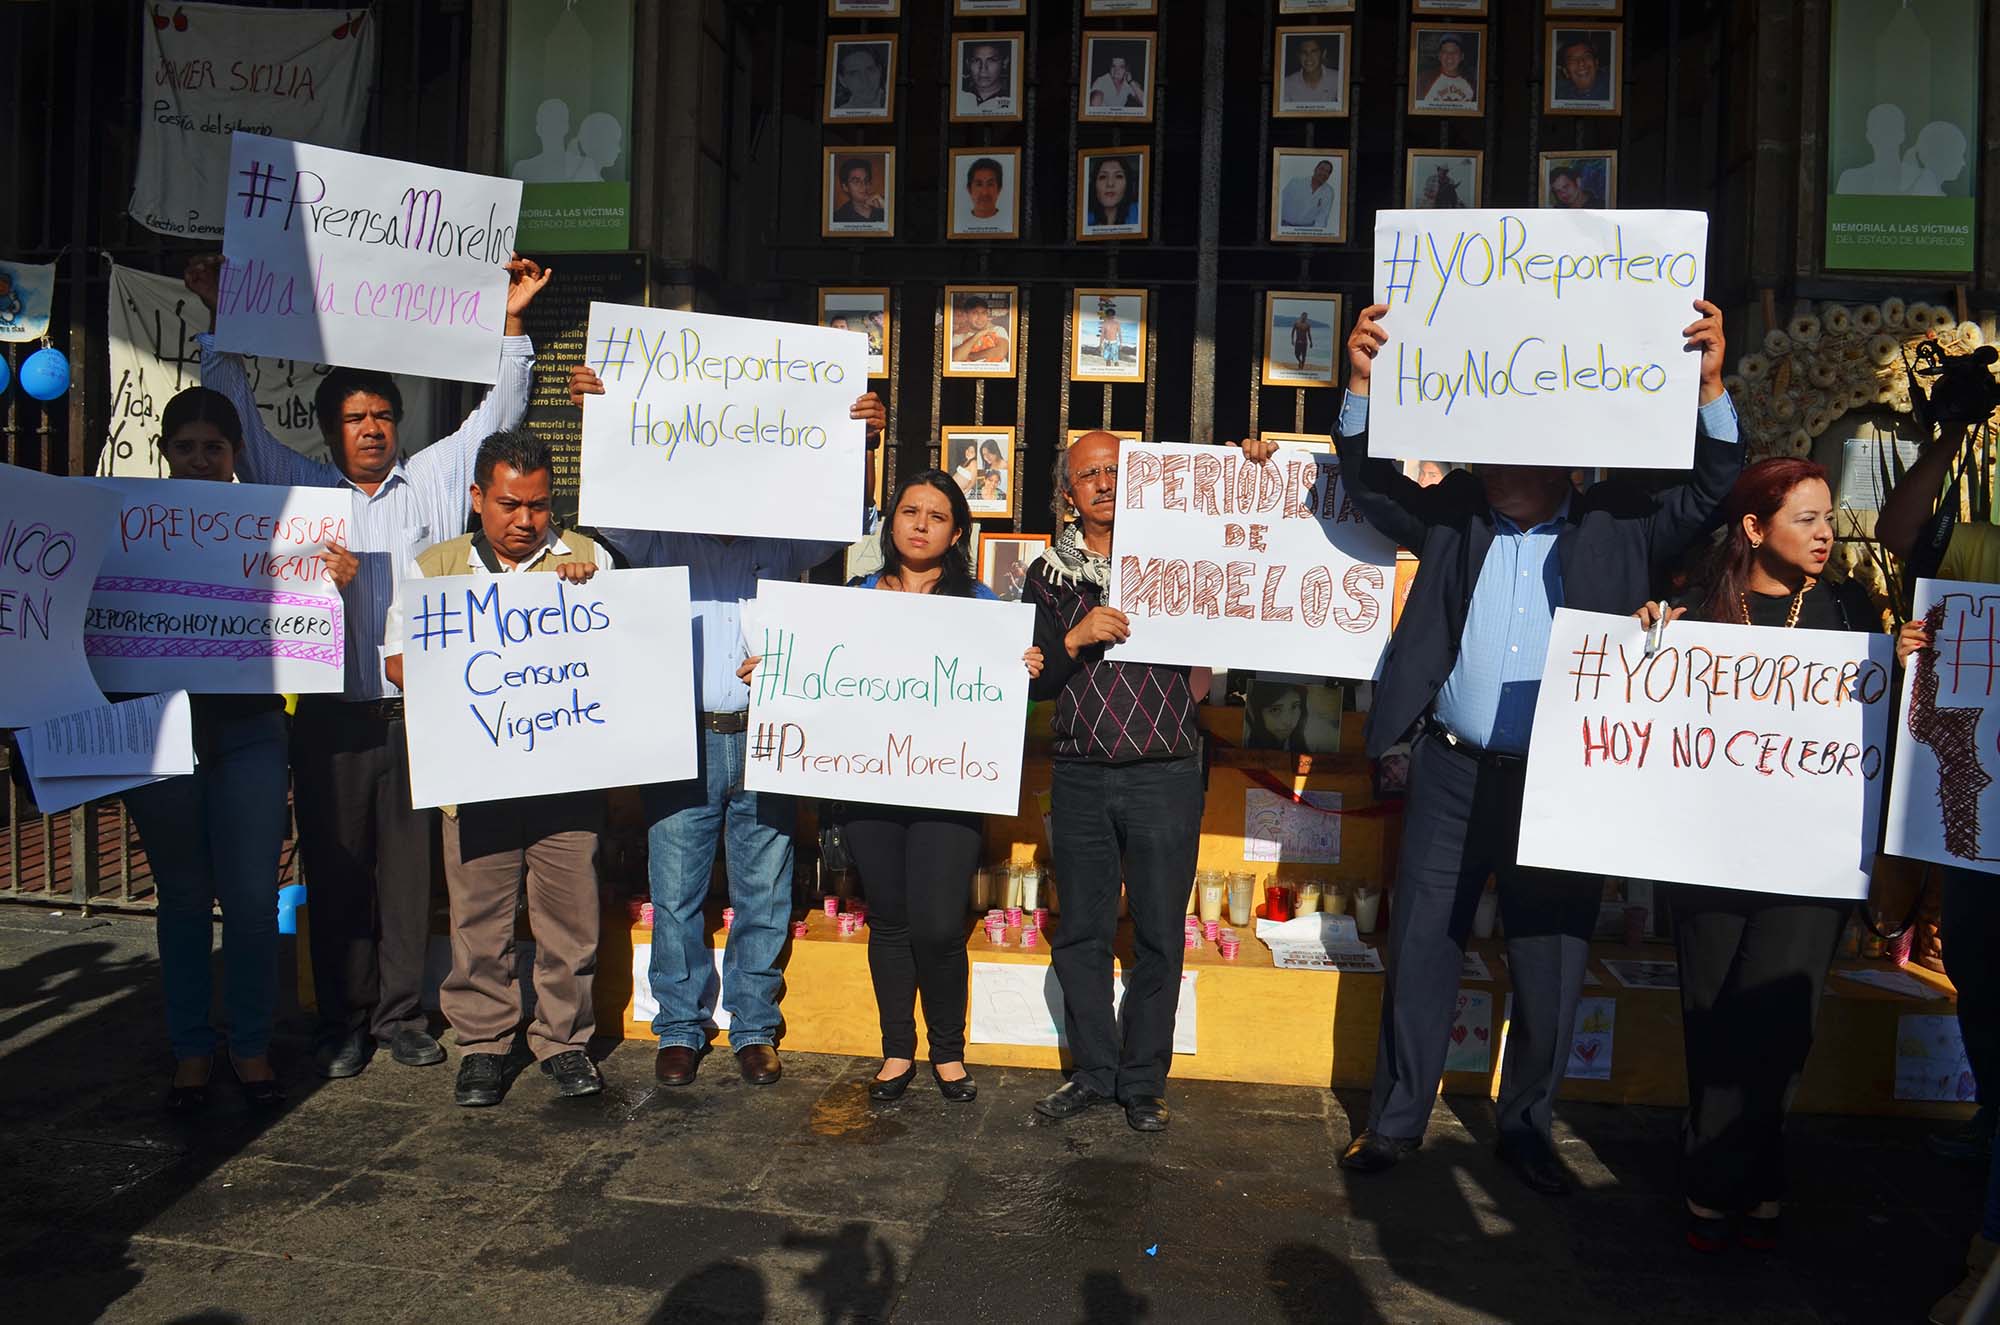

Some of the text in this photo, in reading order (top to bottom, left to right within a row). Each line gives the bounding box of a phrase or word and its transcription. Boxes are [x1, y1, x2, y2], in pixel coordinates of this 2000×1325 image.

[156, 57, 315, 101] JAVIER SICILIA
[154, 100, 195, 131] Poesía
[200, 114, 222, 135] del
[238, 161, 514, 265] #PrensaMorelos
[555, 209, 561, 217] A
[563, 208, 581, 217] LAS
[583, 205, 625, 217] VÍCTIMAS
[1832, 223, 1969, 234] MEMORIAL A LAS VÍCTIMAS
[1836, 235, 1965, 246] DEL ESTADO DE MORELOS
[312, 254, 344, 315] la
[355, 280, 494, 332] censura
[553, 342, 584, 350] Romero
[1396, 336, 1667, 416] HoyNoCelebro
[528, 420, 566, 429] memorial
[553, 432, 564, 440] los
[631, 401, 827, 461] HoyNoCelebro
[1222, 522, 1269, 553] DE
[411, 582, 610, 650] #Morelos
[1119, 554, 1385, 634] MORELOS
[464, 650, 590, 696] Censura
[756, 628, 1003, 707] #LaCensuraMata
[1568, 633, 1887, 715] #YOREPORTERO
[469, 687, 606, 752] Vigente
[1582, 715, 1882, 781] HOY NO CELEBRO
[751, 722, 1000, 781] #PrensaMorelos
